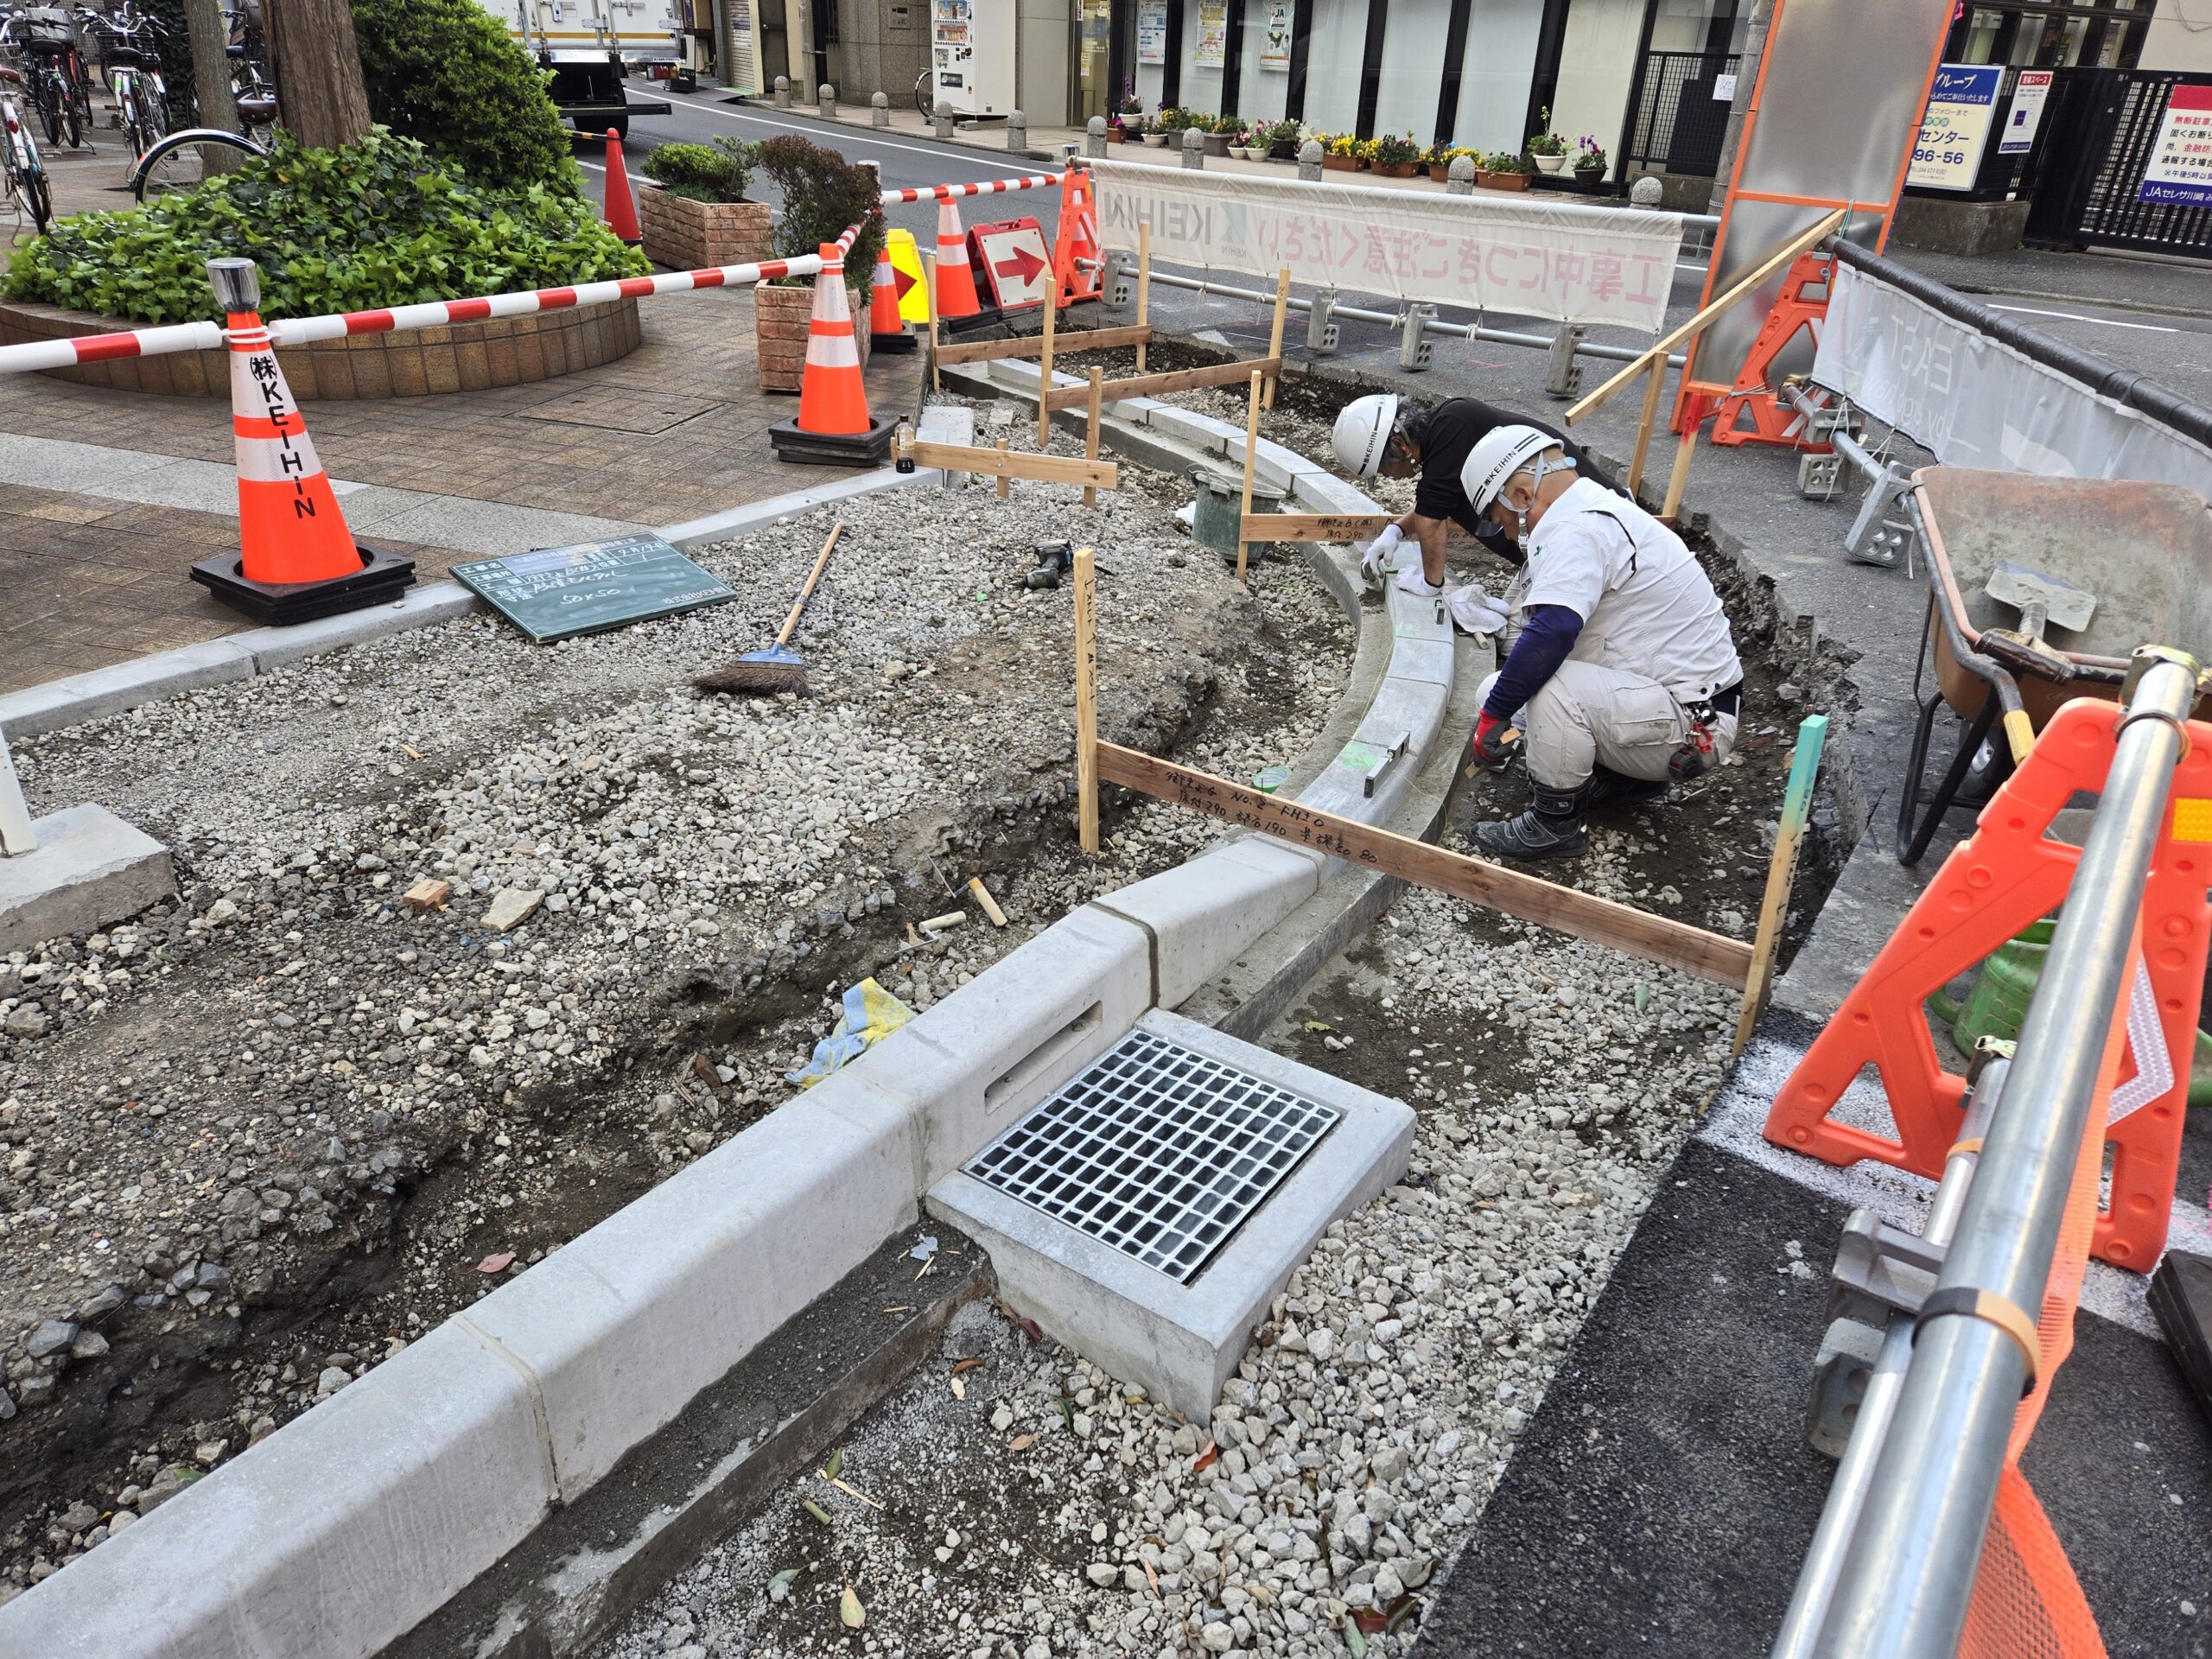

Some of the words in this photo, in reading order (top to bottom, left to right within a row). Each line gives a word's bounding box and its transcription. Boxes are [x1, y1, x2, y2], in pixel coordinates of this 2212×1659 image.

[2173, 116, 2212, 126] 無断駐車
[1920, 130, 1970, 144] センター
[1913, 149, 1965, 165] 96-56
